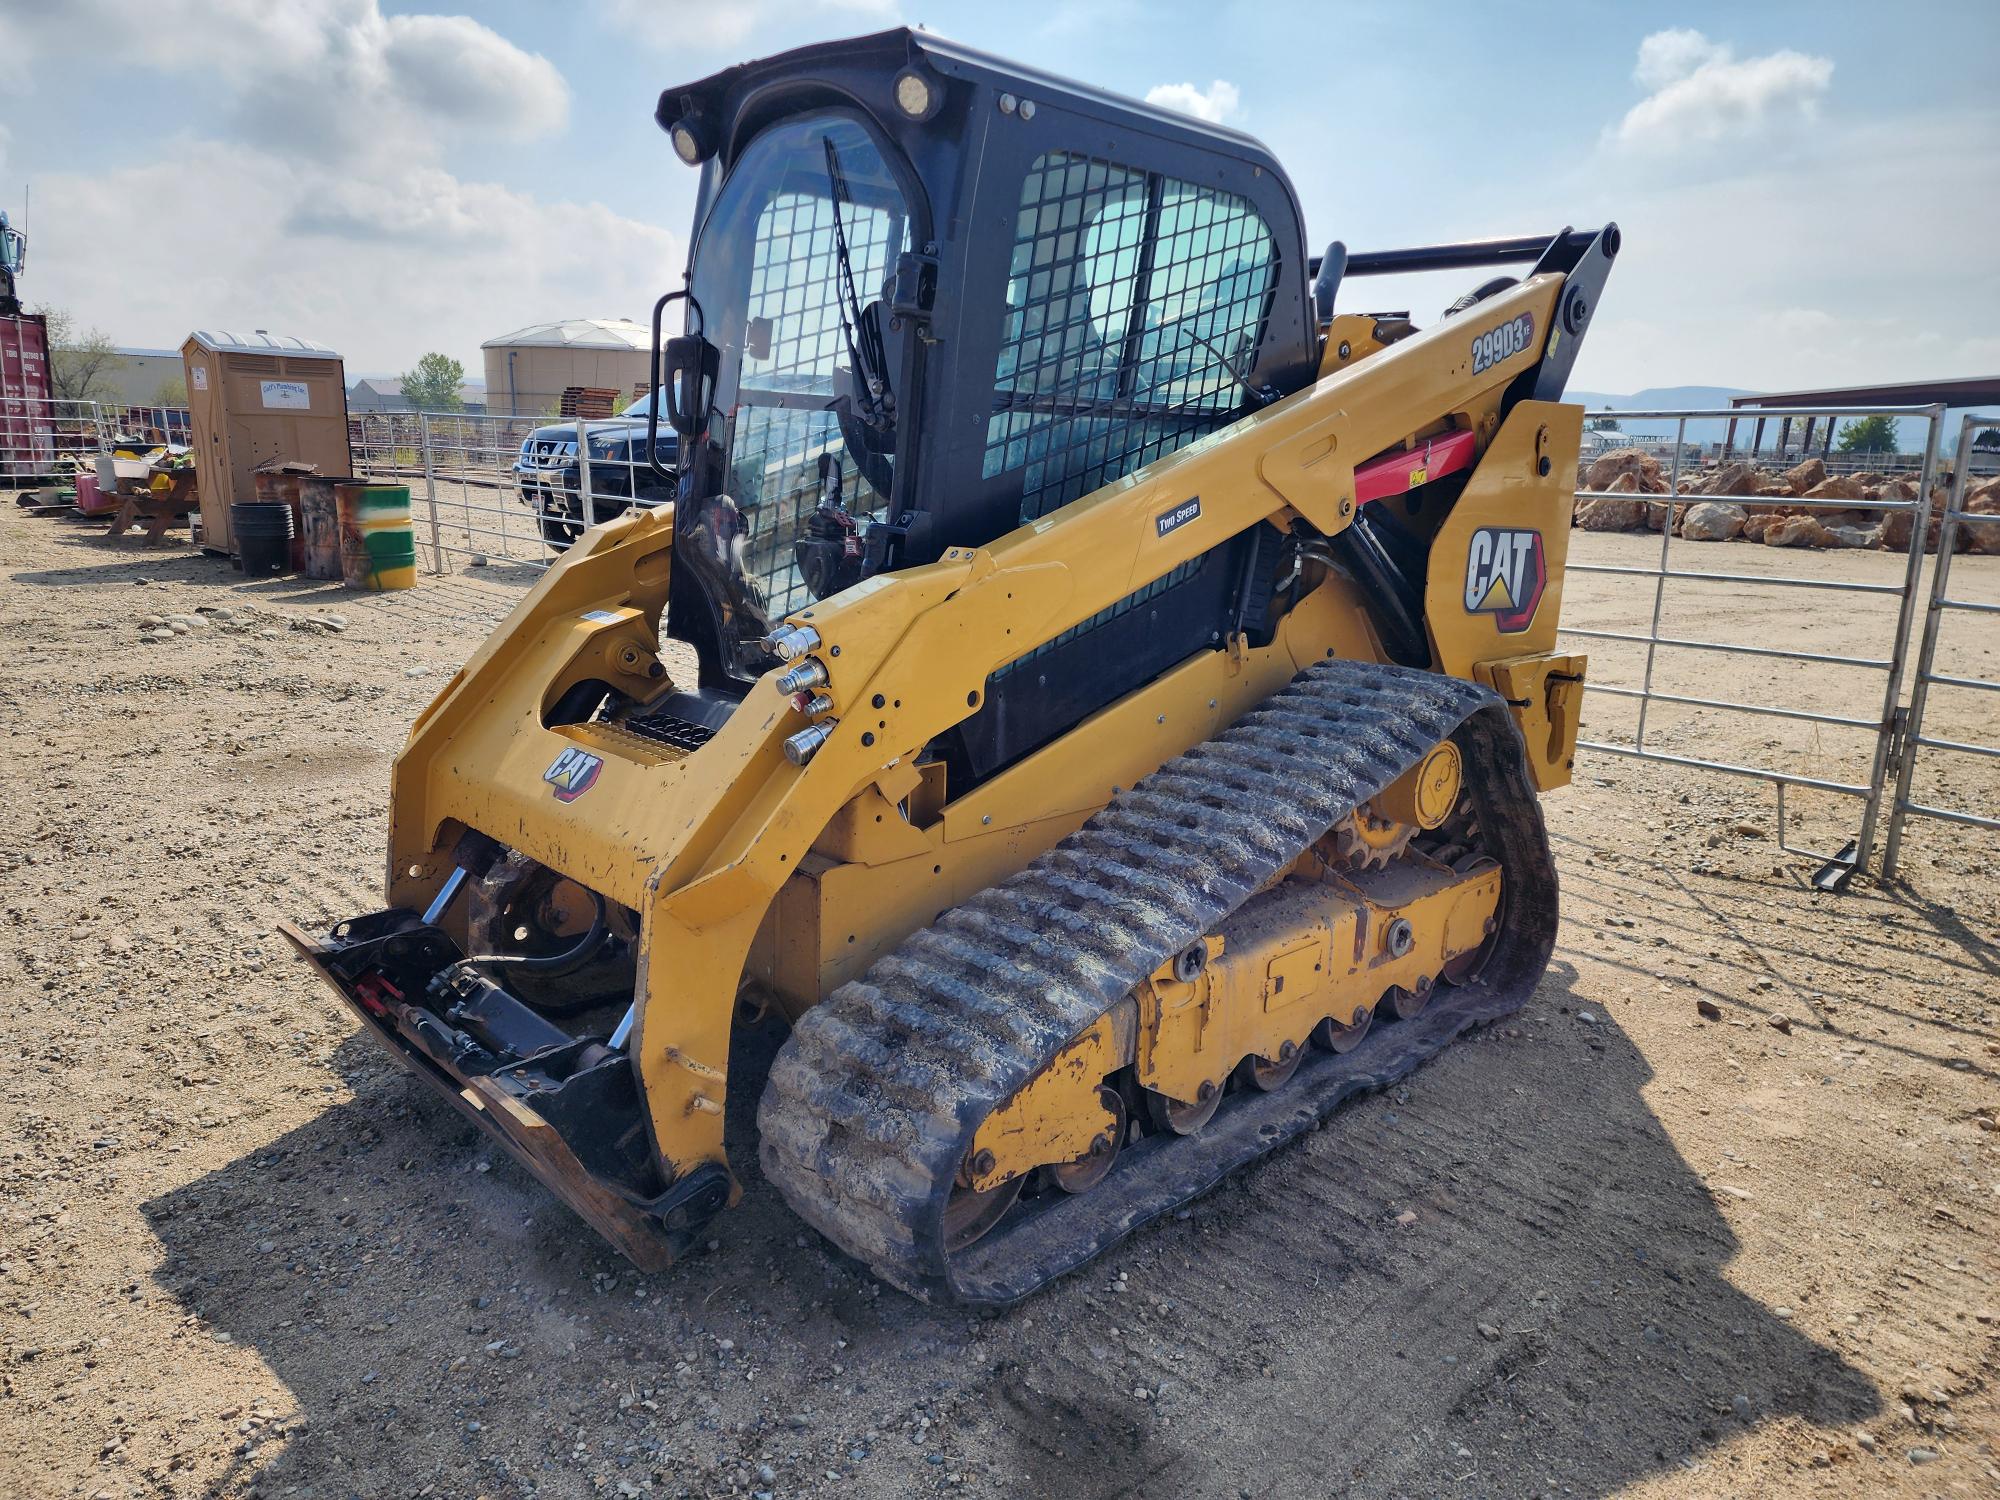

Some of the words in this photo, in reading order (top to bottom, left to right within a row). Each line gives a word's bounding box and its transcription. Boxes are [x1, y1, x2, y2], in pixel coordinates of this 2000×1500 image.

[1472, 318, 1524, 374] 299D3
[276, 383, 298, 392] Plumbing
[1465, 530, 1534, 610] CAT
[544, 748, 600, 791] CAT
